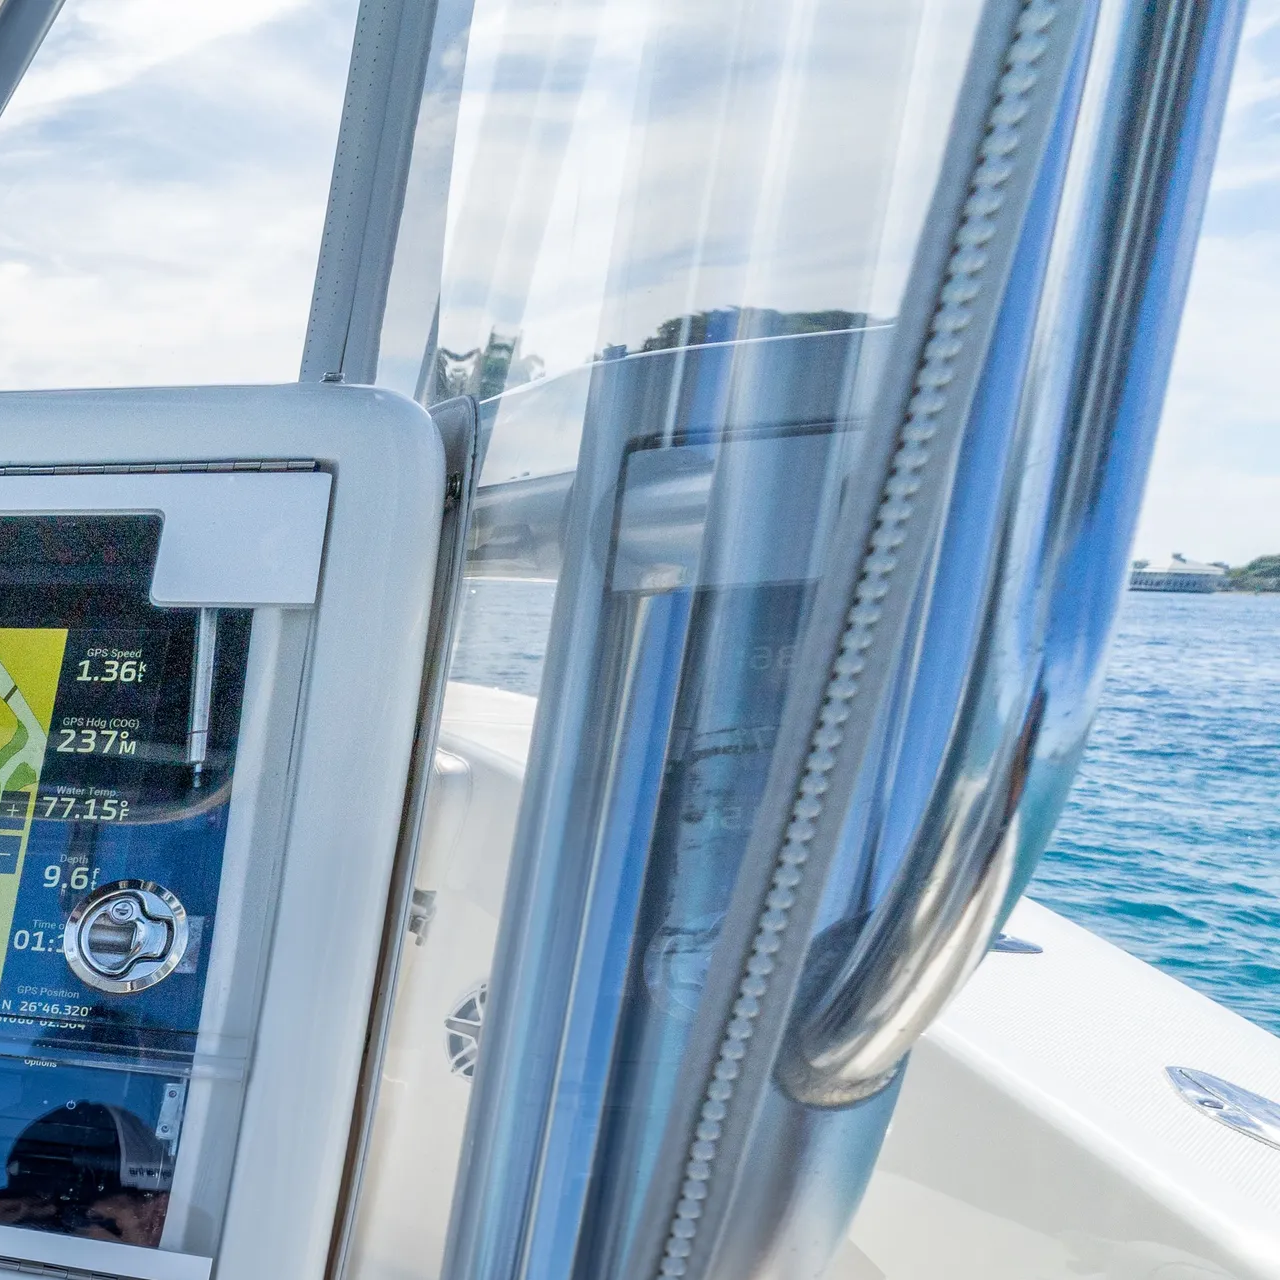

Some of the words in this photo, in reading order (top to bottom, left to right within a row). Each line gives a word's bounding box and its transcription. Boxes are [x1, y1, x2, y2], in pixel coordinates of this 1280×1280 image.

[87, 648, 108, 657] GPS
[111, 648, 142, 659] Speed
[62, 717, 84, 727] GPS
[86, 718, 107, 729] Hdg
[109, 718, 140, 730] (COG)
[57, 786, 85, 796] Water
[60, 854, 89, 865] Depth
[32, 919, 57, 929] Time
[17, 985, 38, 995] GPS
[41, 986, 80, 999] Position
[1, 1000, 12, 1010] N
